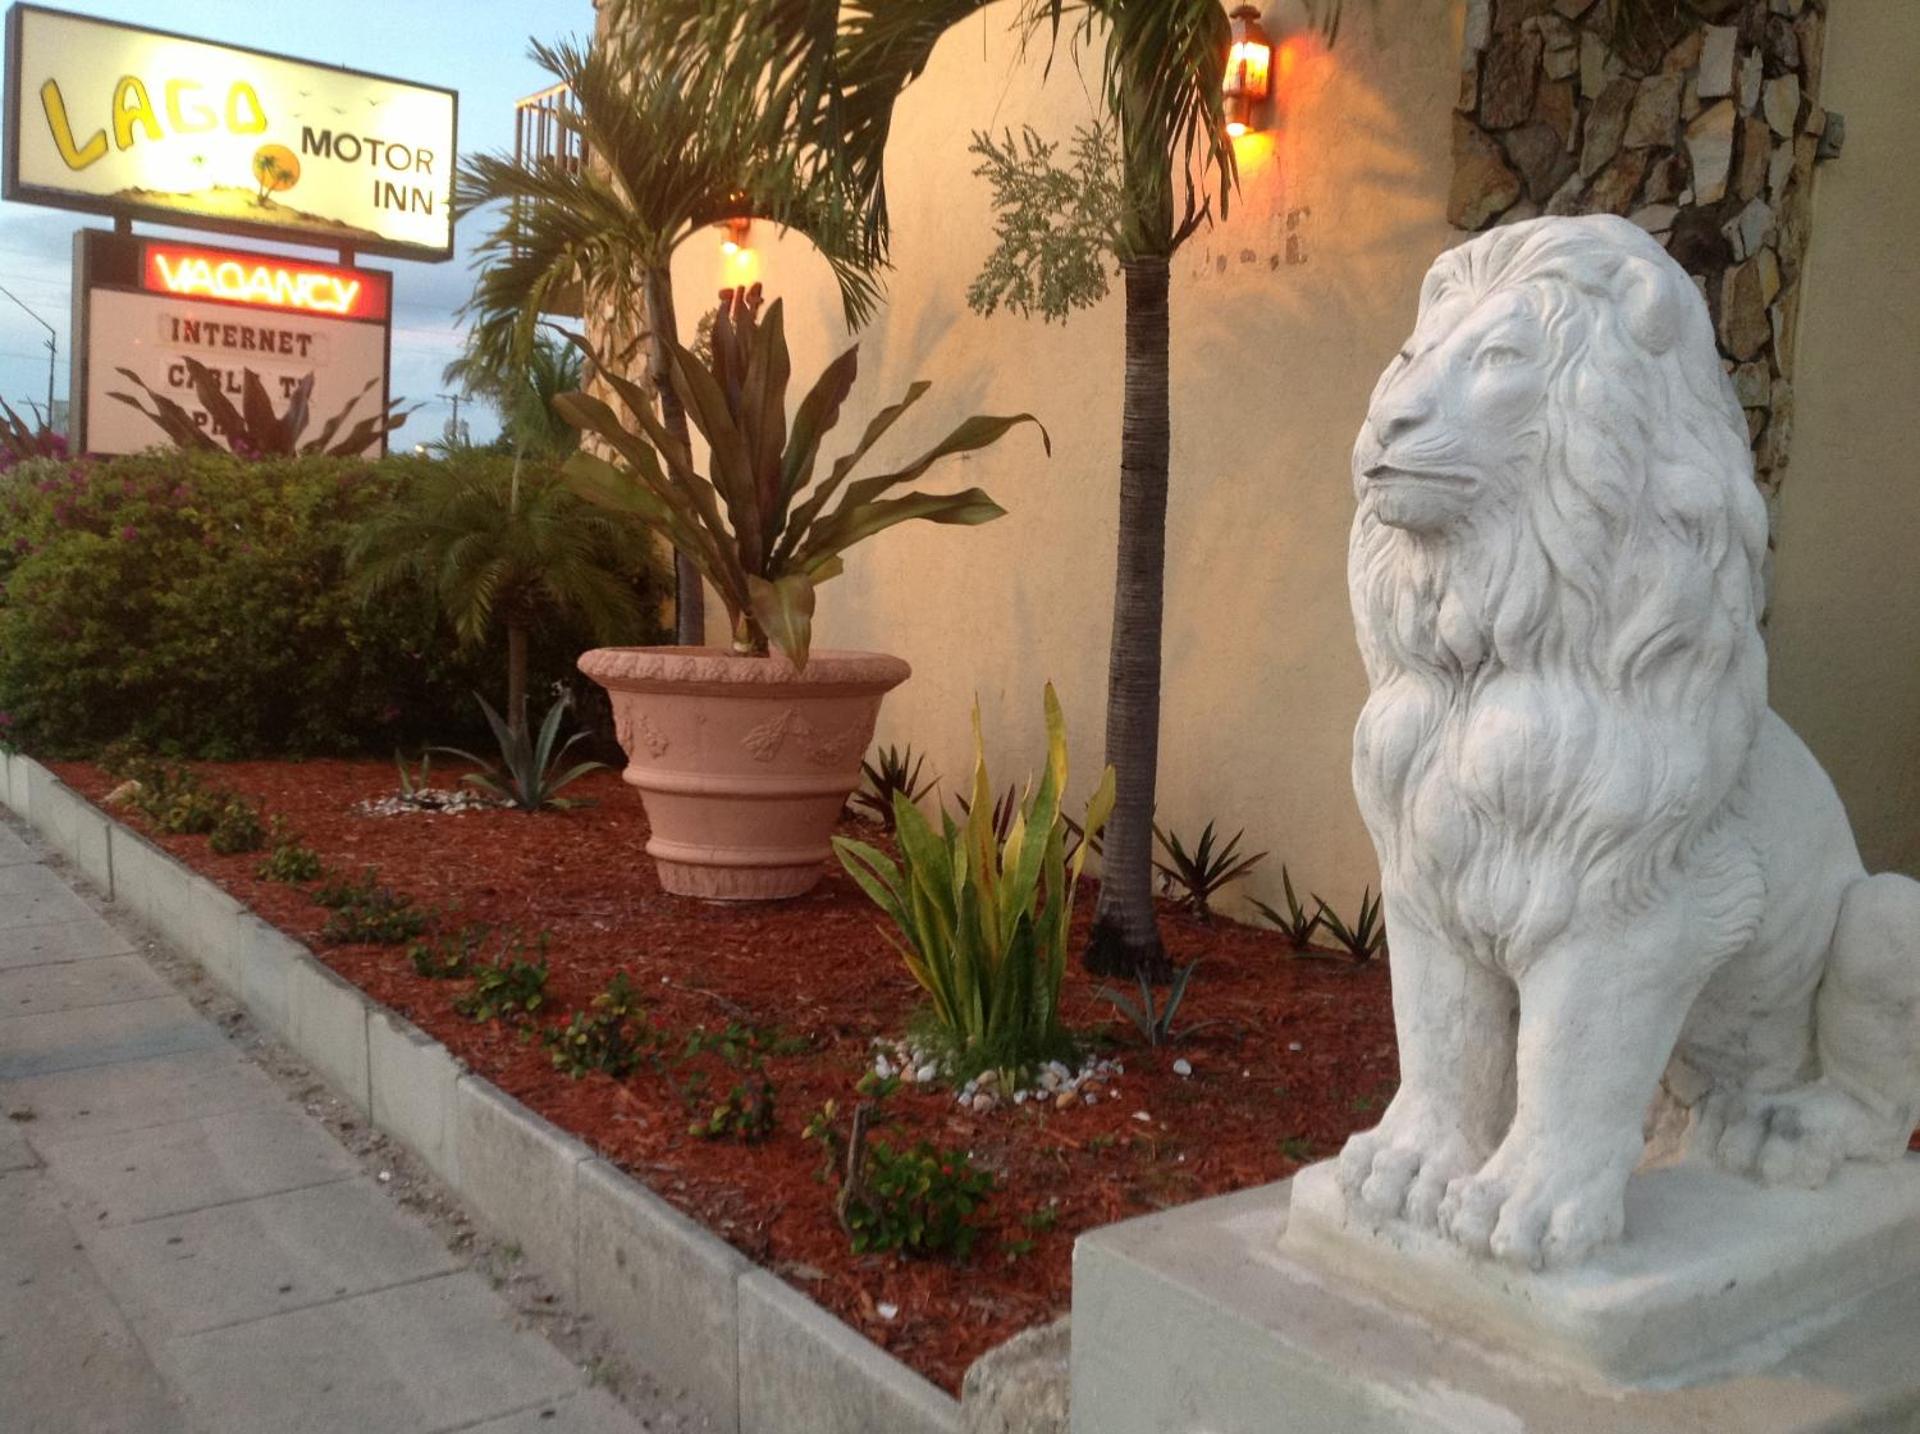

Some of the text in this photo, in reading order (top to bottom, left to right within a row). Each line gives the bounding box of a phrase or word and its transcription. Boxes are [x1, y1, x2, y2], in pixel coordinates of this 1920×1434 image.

[40, 75, 267, 171] LAGO
[301, 126, 435, 175] MOTOR
[374, 179, 434, 216] INN
[154, 252, 361, 315] VACANCY
[170, 317, 313, 358] INTERNET
[279, 375, 315, 402] T
